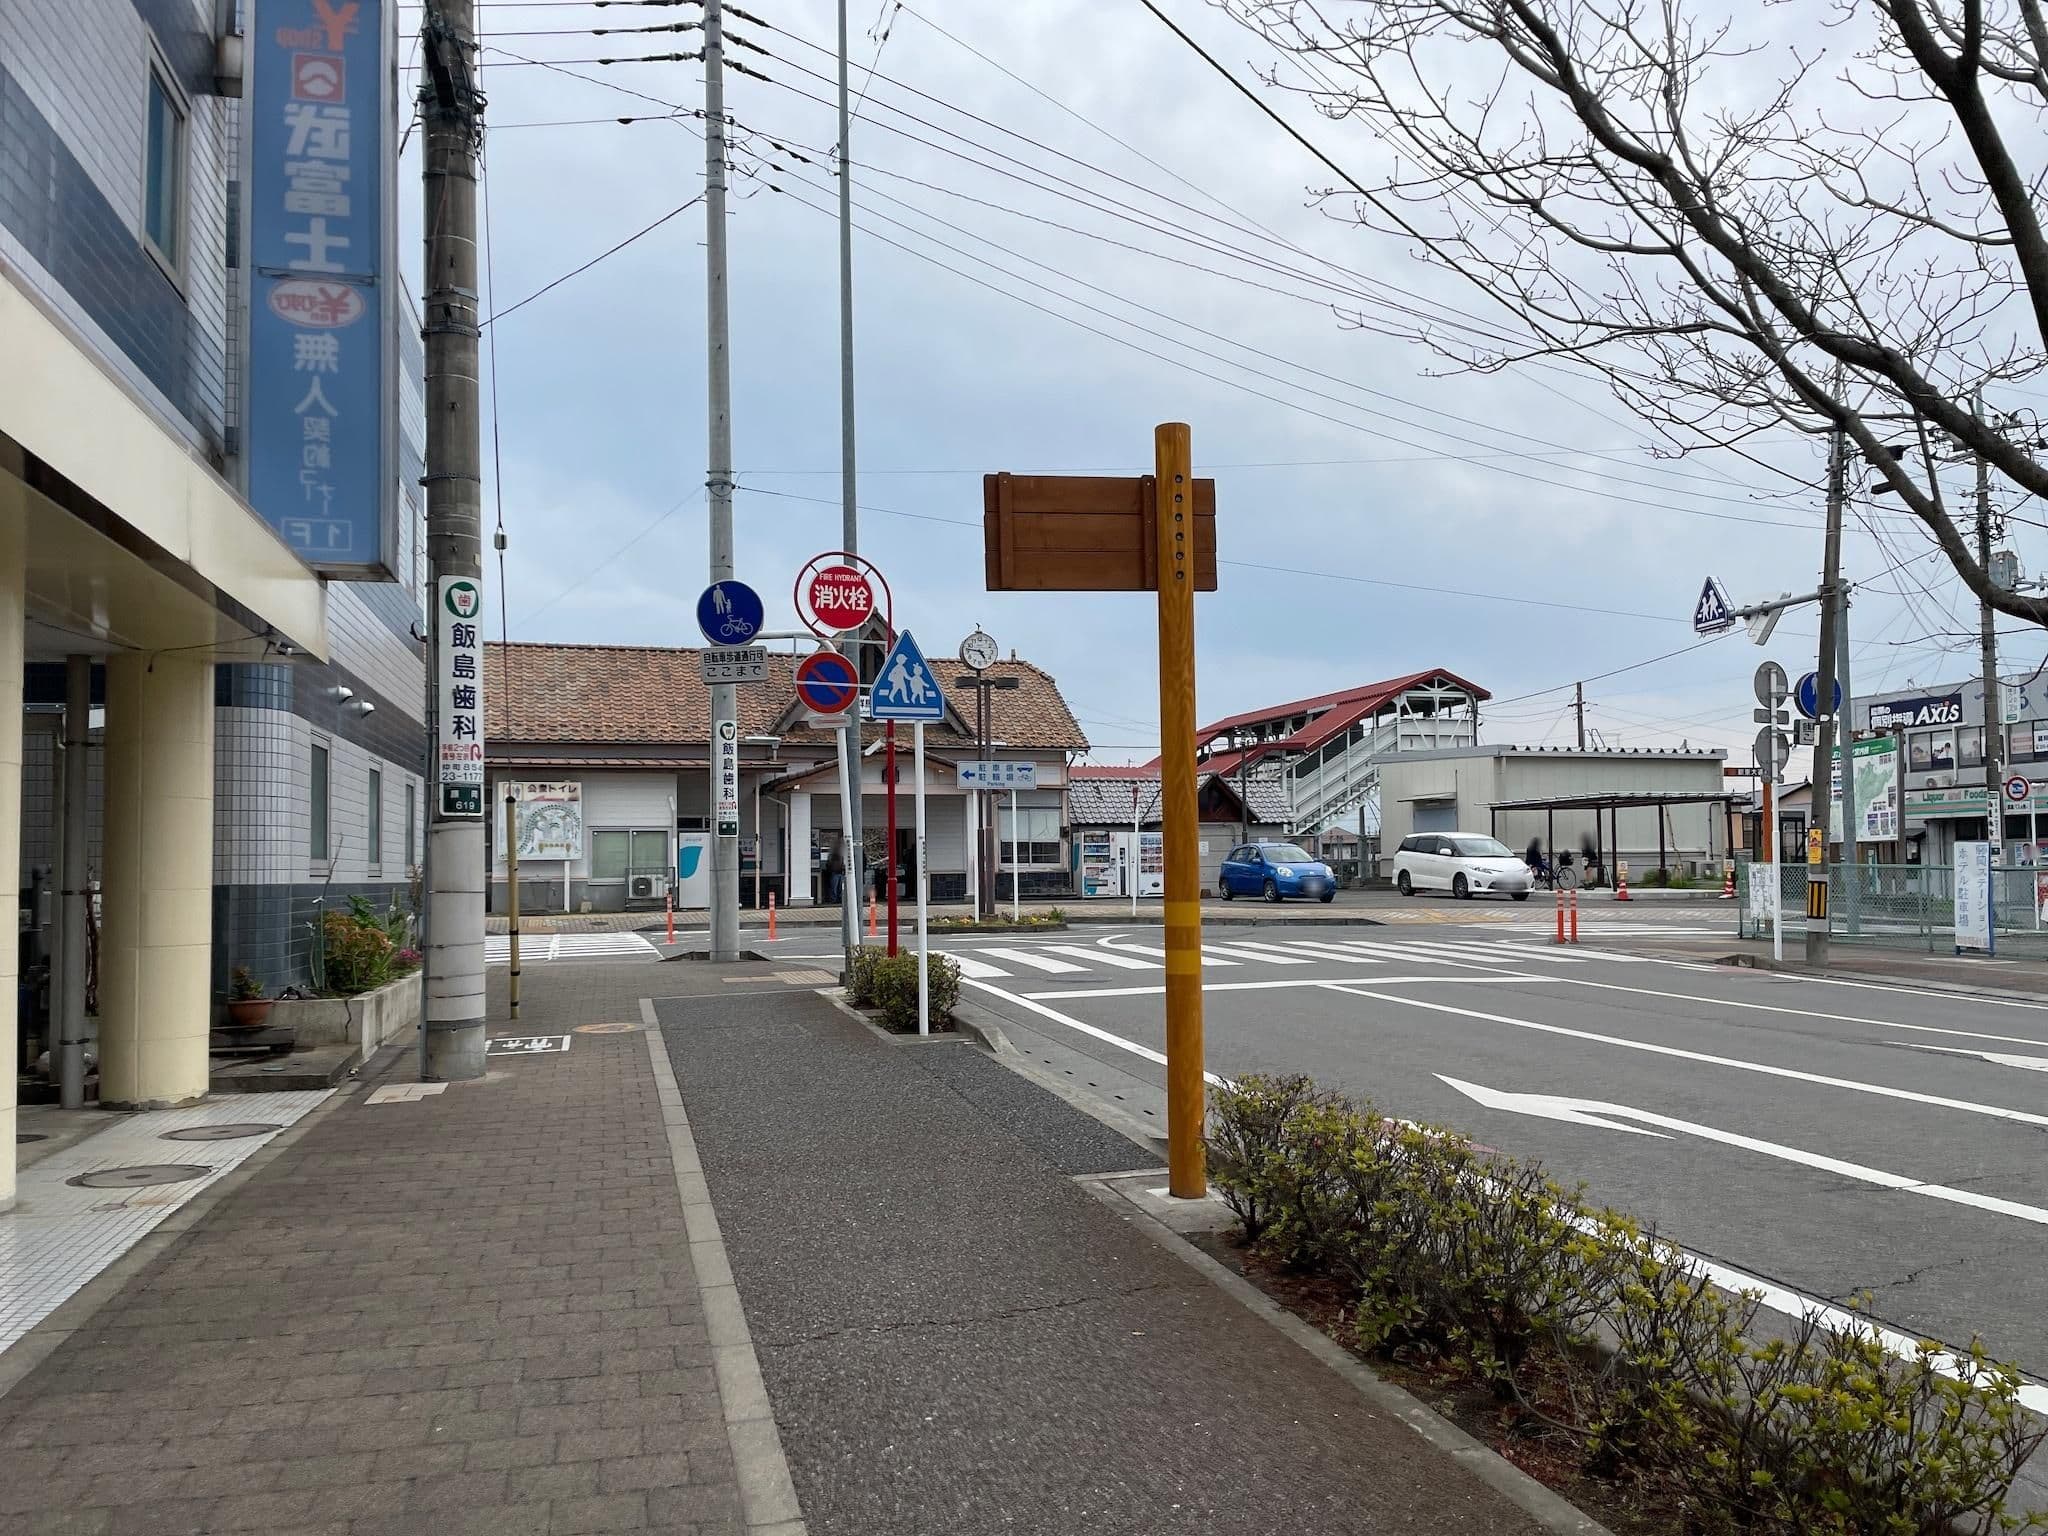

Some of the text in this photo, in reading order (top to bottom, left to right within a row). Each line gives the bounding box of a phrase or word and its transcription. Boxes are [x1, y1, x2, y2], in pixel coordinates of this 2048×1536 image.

[814, 584, 868, 610] 消火栓
[706, 665, 763, 677] ここまで
[451, 621, 477, 741] 飯島歯科
[455, 801, 475, 810] 619
